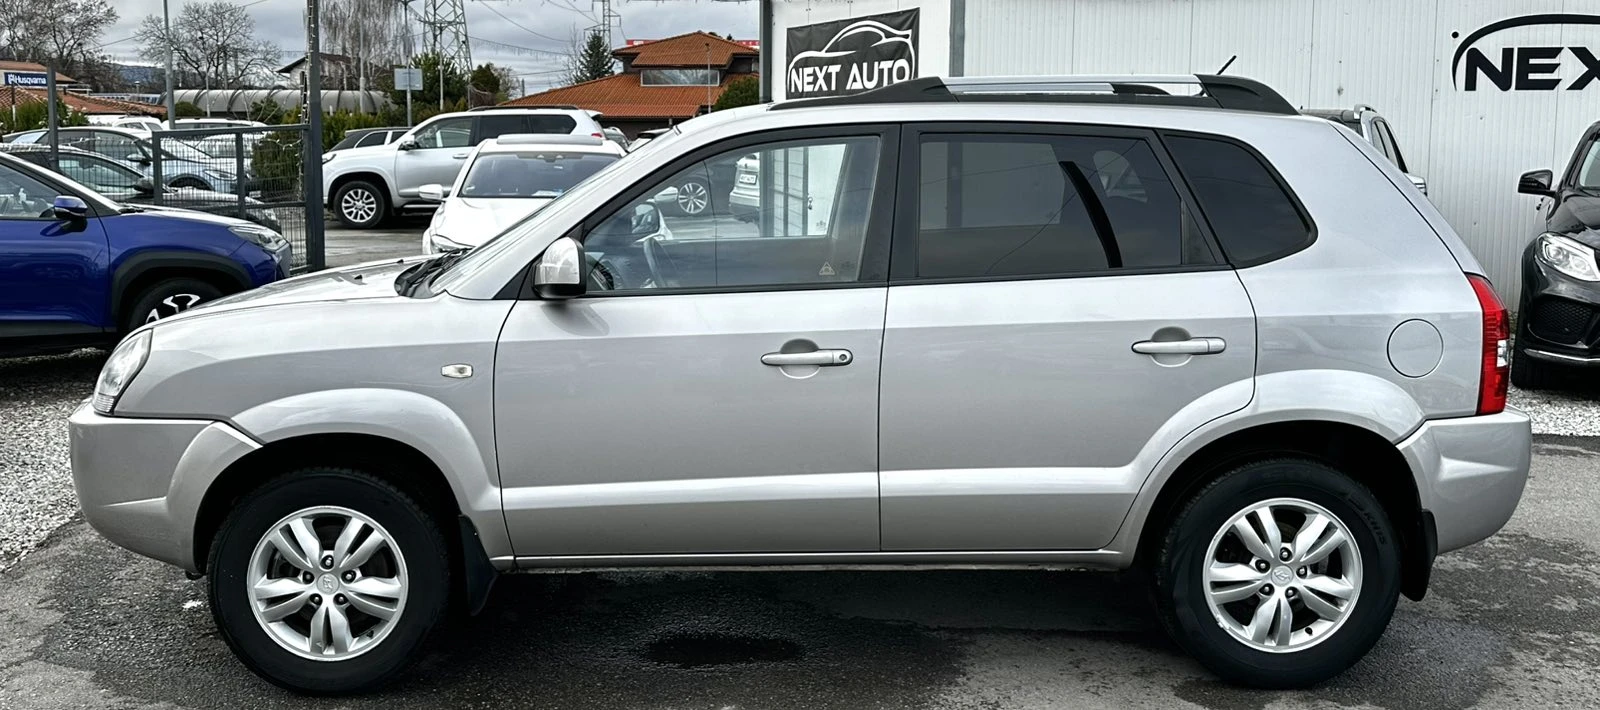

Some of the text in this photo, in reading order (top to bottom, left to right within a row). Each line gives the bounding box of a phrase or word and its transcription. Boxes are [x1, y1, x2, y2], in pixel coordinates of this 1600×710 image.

[15, 75, 46, 85] Husqvarna
[791, 59, 910, 92] NEXT AUTO
